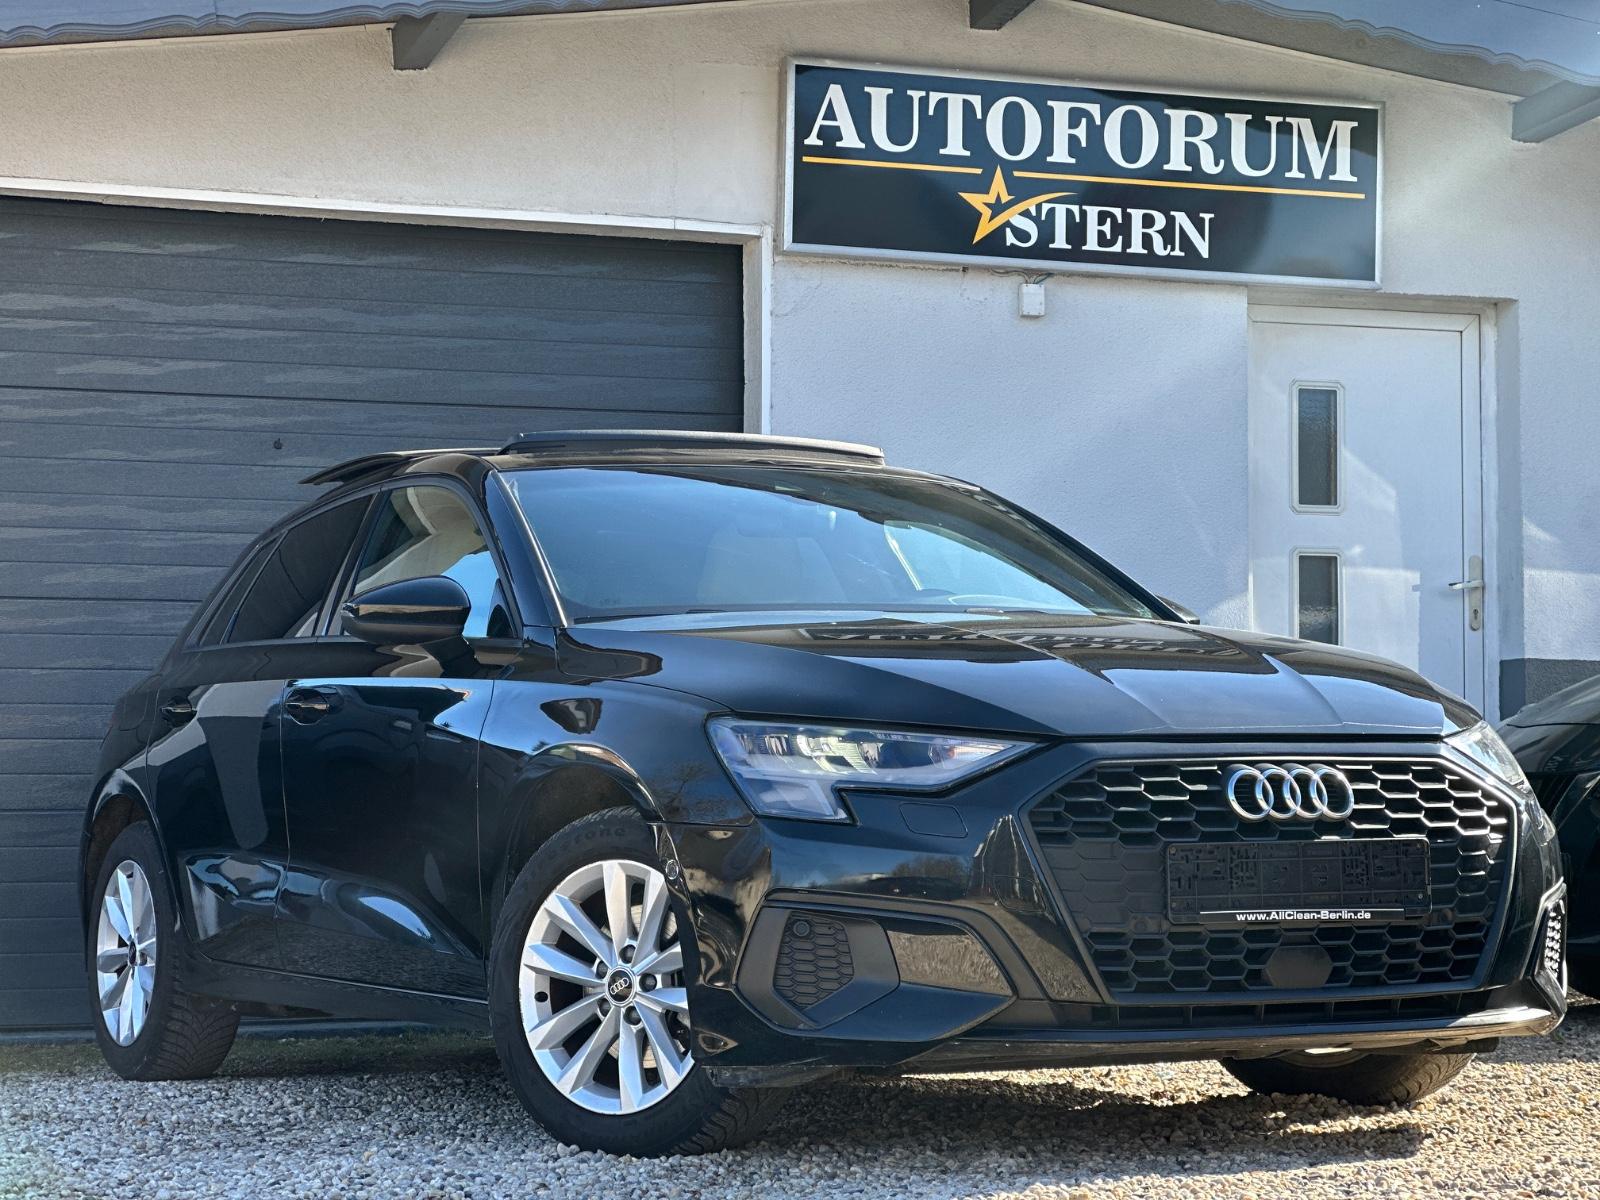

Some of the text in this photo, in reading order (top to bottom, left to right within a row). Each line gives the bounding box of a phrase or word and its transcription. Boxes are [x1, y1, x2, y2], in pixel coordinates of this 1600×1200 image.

[803, 83, 1359, 183] AUTOFORUM
[1004, 201, 1214, 259] STERN
[1236, 910, 1372, 921] www.AllClean-Berlin.de
